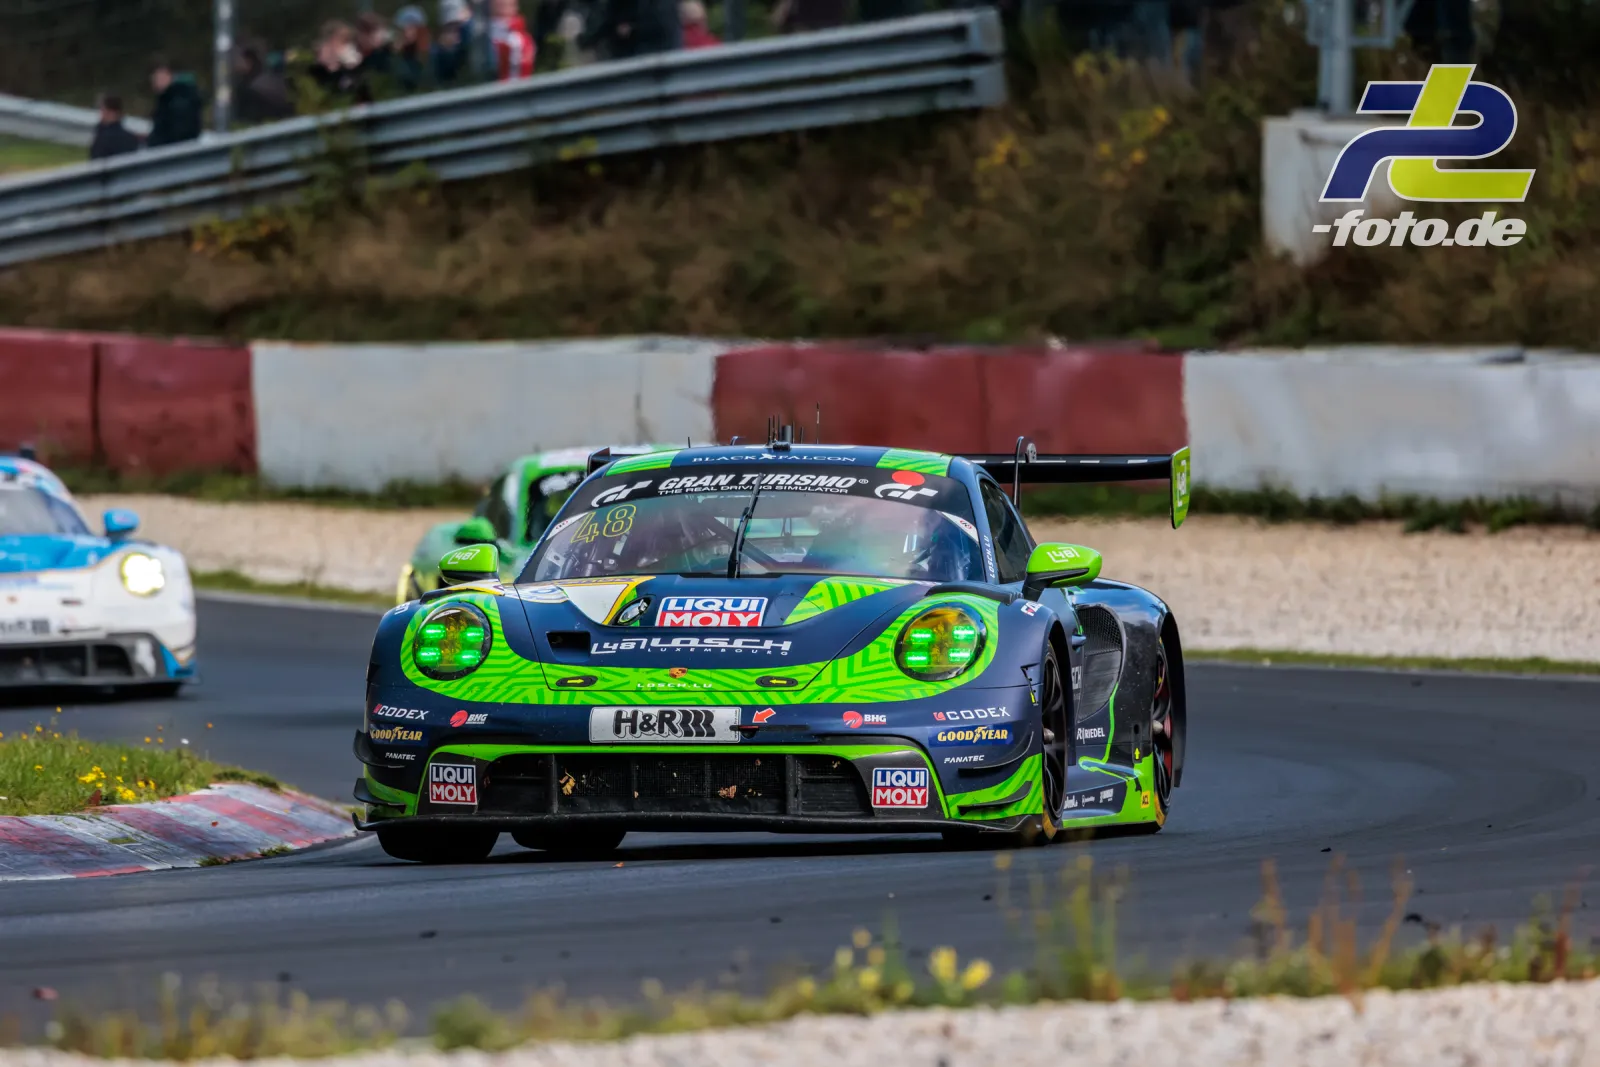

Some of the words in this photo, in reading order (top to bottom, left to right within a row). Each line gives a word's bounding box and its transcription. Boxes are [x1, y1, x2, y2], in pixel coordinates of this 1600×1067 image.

[692, 455, 757, 463] BLACK
[658, 474, 736, 490] GRAN
[775, 485, 849, 493] SIMULATOR
[570, 504, 637, 544] 48
[667, 598, 760, 612] LIQUI
[663, 612, 759, 627] MOLY
[650, 637, 792, 651] LOSCH
[647, 647, 788, 656] LUXEMBOURG
[377, 705, 429, 720] CODEX
[864, 713, 887, 722] BHG
[946, 706, 1011, 720] CODEX
[613, 709, 684, 738] H&R
[937, 726, 1008, 743] GOODYEAR
[1085, 727, 1106, 739] RIEDEL
[384, 752, 417, 760] FANATEC
[944, 755, 985, 763] FANATEC
[432, 766, 473, 784] LIQUI
[876, 770, 925, 787] LIQUI
[432, 784, 475, 801] MOLY
[875, 787, 927, 805] MOLY
